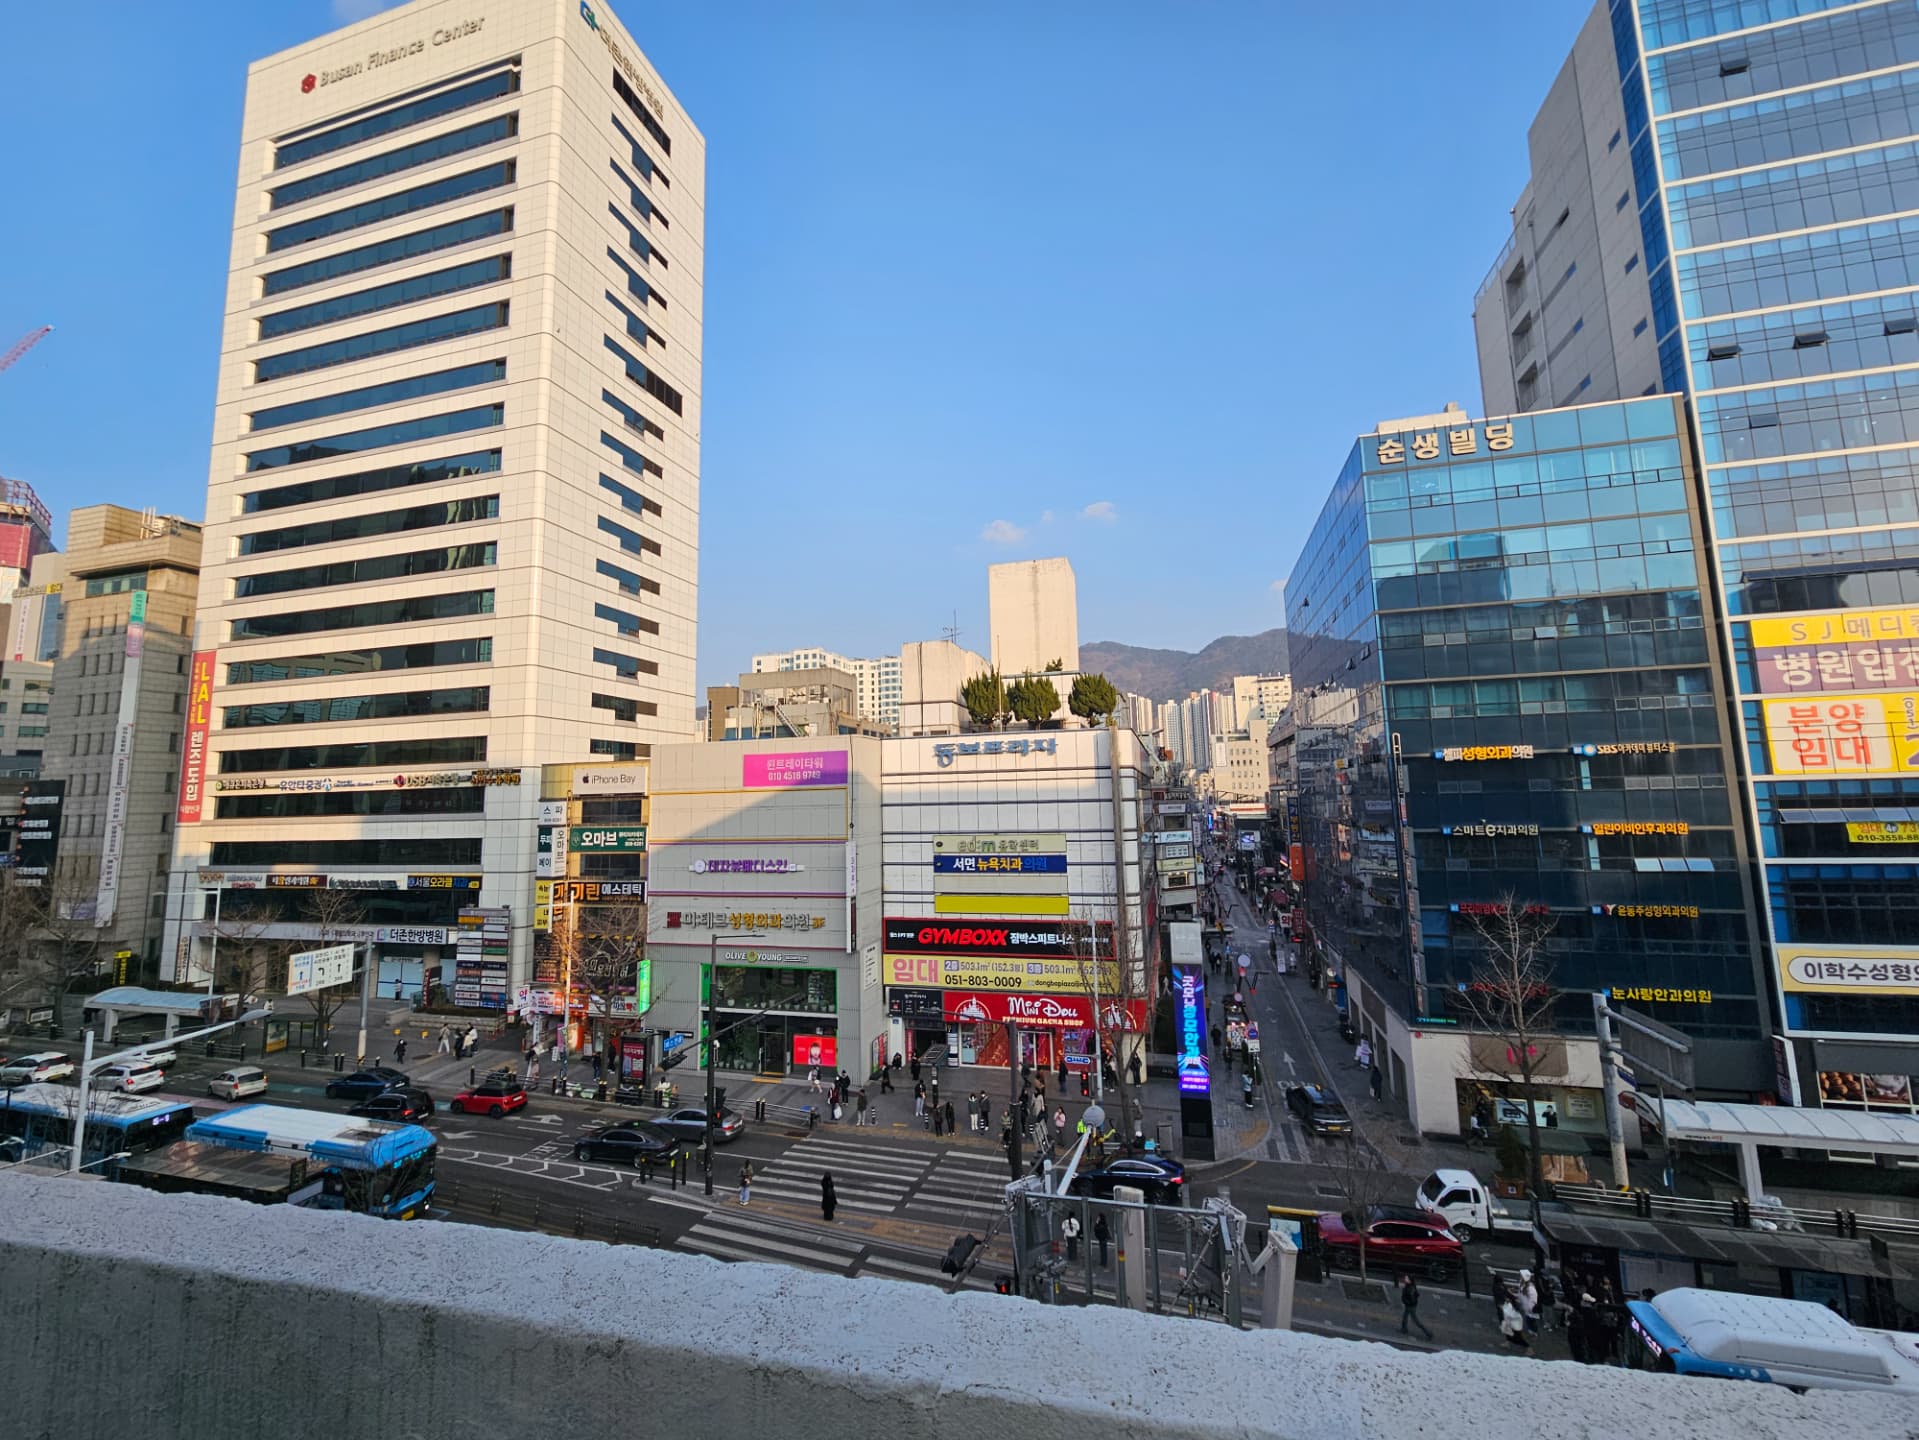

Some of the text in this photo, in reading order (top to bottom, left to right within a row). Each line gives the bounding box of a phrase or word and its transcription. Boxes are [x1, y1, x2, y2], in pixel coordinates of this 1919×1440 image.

[320, 17, 485, 87] Busan Finance Center
[1788, 704, 1865, 735] 분양
[935, 738, 1056, 768] 동보프라자
[1792, 736, 1872, 767] 임대
[280, 780, 323, 791] 유안타증권
[592, 774, 636, 786] iPhone Bay
[1593, 823, 1688, 835] 열린이비인후과의원
[580, 831, 618, 848] 오마브
[953, 857, 976, 871] 서면
[977, 857, 1022, 871] 뉴욕치과
[570, 883, 641, 901] 기린 에스테틱
[390, 928, 443, 943] 더존한방병원
[918, 928, 1010, 946] GYMBOXX
[725, 952, 747, 961] OLIVE
[757, 953, 782, 961] YOUNG
[893, 959, 939, 984] 임대
[945, 975, 1022, 987] 051-803-0009
[1612, 987, 1712, 1003] 눈사랑안과의원
